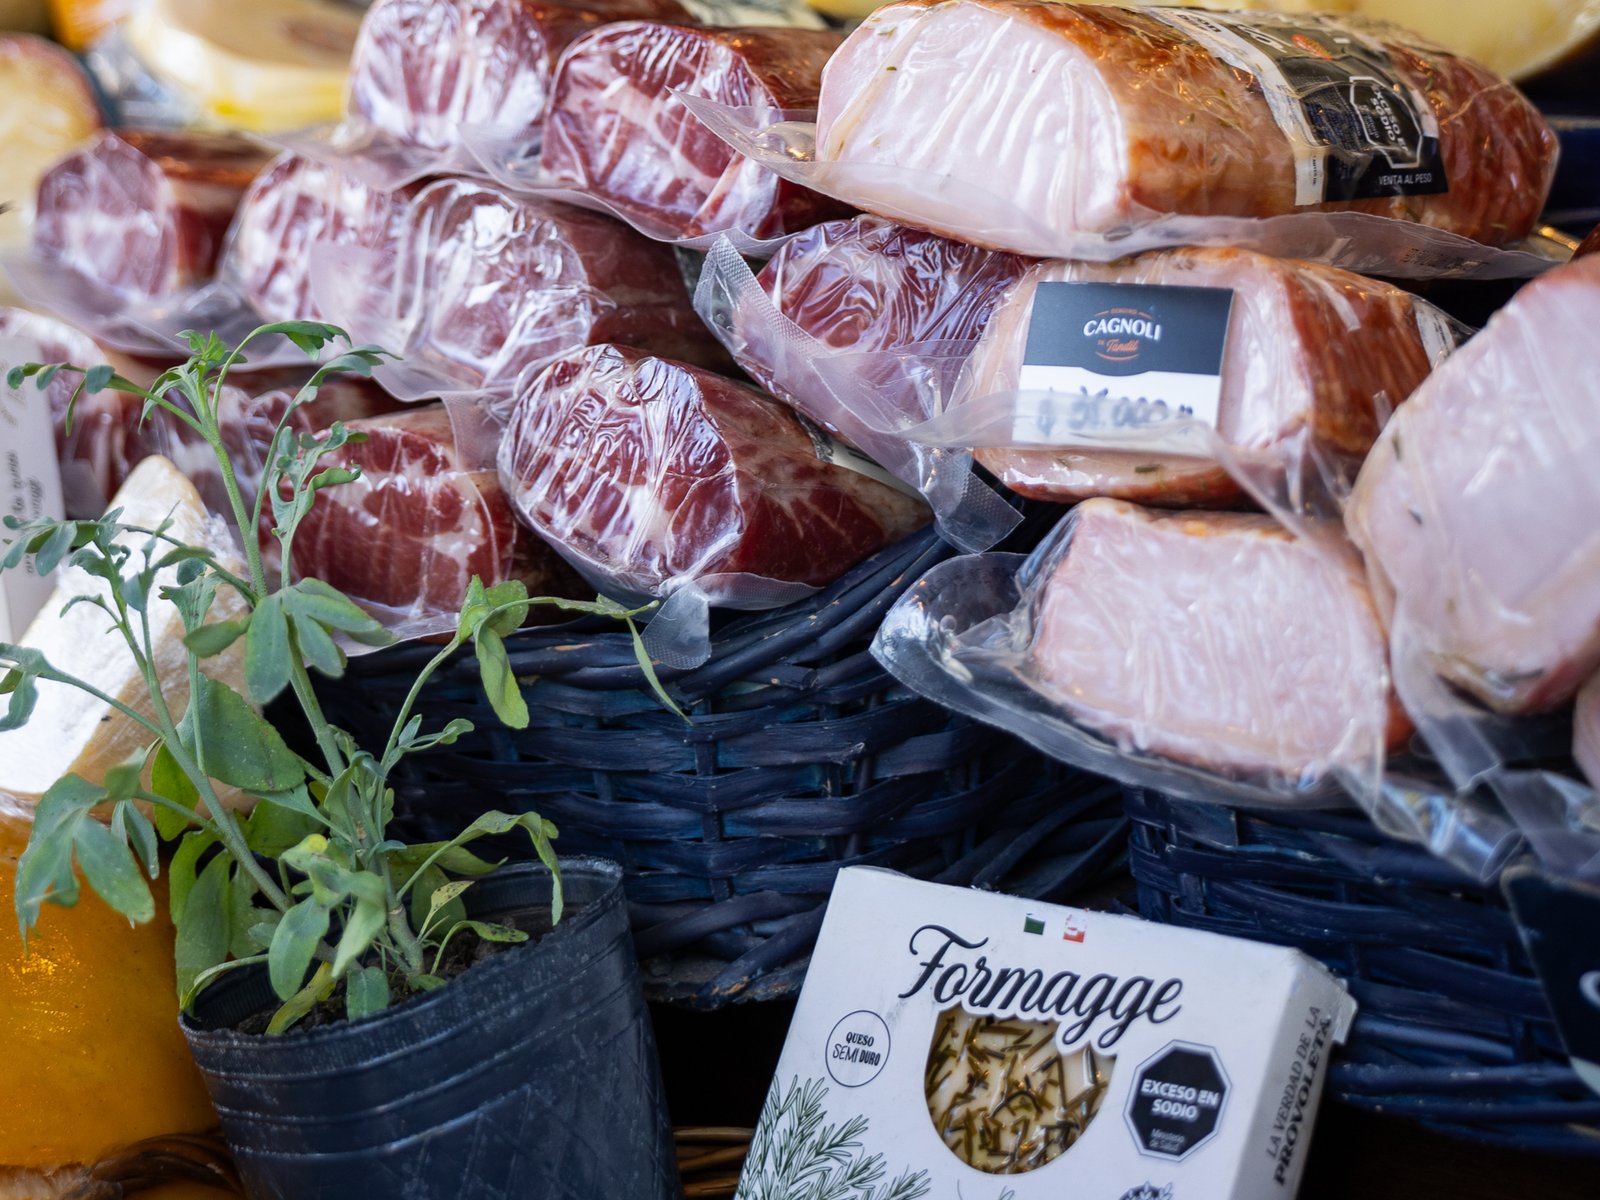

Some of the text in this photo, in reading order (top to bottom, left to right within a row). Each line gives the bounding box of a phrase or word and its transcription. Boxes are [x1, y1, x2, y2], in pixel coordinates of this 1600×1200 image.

[1370, 97, 1396, 141] SODIO
[1378, 173, 1432, 186] VENTA AL PESO
[1083, 317, 1162, 341] CAGNOLI
[897, 924, 1184, 1049] Formagge
[846, 1031, 875, 1047] QUESO
[832, 1043, 881, 1066] SEMI DURO
[1141, 1078, 1220, 1106] EXCESO EN
[1266, 1006, 1320, 1159] LA VERDAD DE LA
[1151, 1098, 1198, 1120] SODIO
[1273, 1018, 1332, 1187] PROVOLETA
